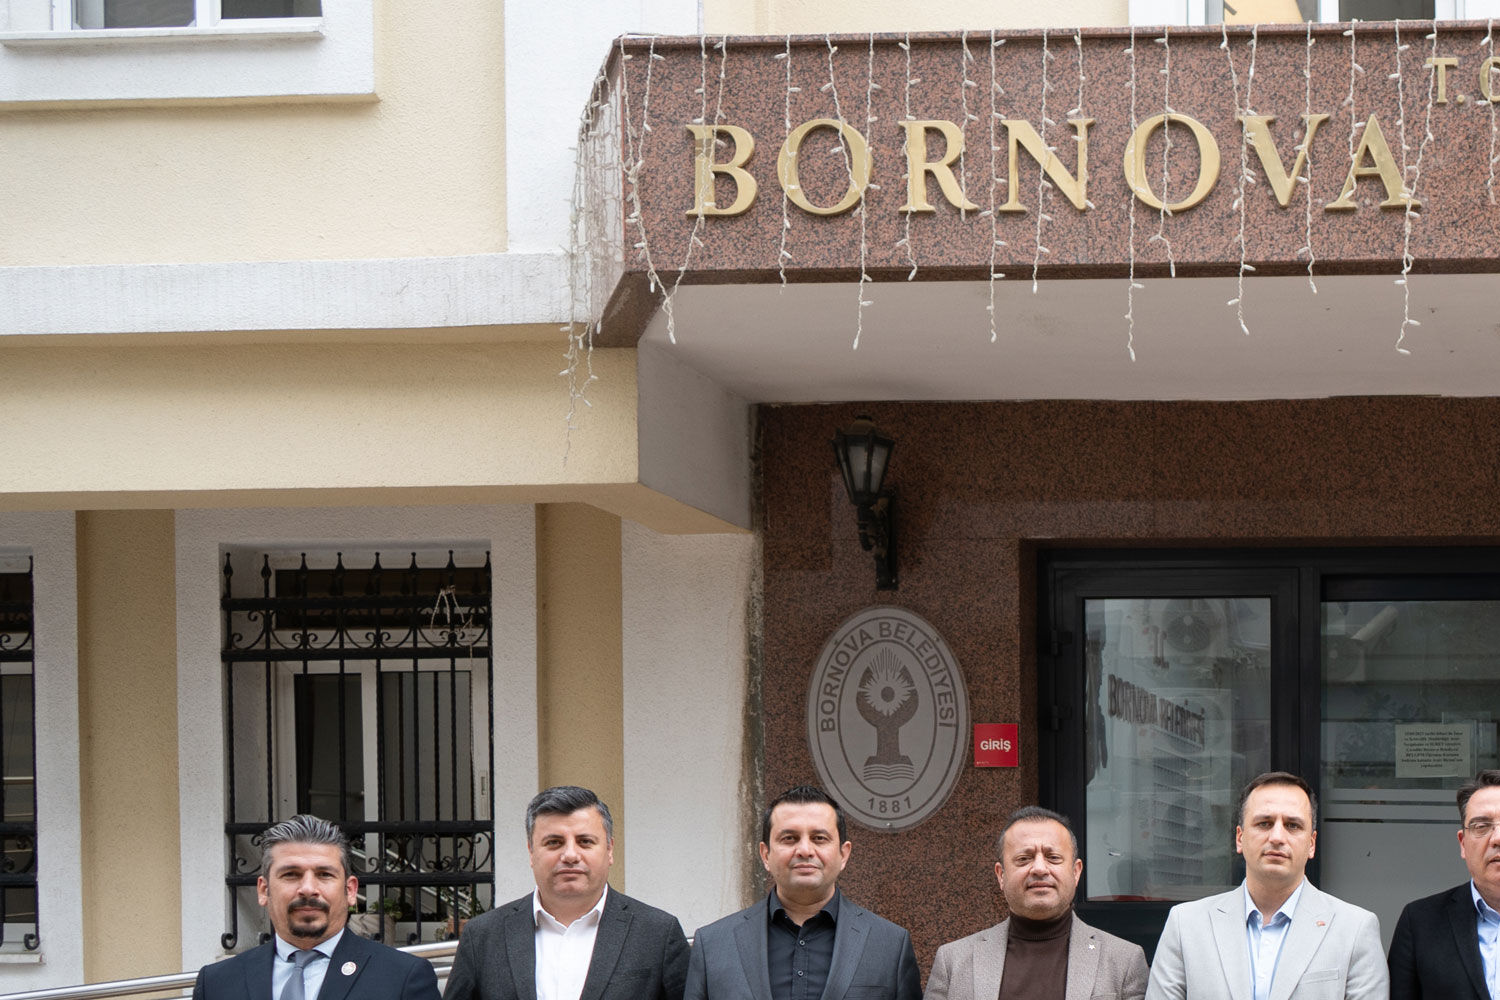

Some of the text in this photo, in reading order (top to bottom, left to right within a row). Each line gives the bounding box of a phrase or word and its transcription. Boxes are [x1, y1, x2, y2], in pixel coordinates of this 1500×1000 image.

[686, 113, 1421, 217] BORNOVA
[820, 621, 956, 733] BORNOVA BELEDİYESİ
[980, 738, 1012, 752] GİRİŞ
[867, 795, 912, 814] 1881
